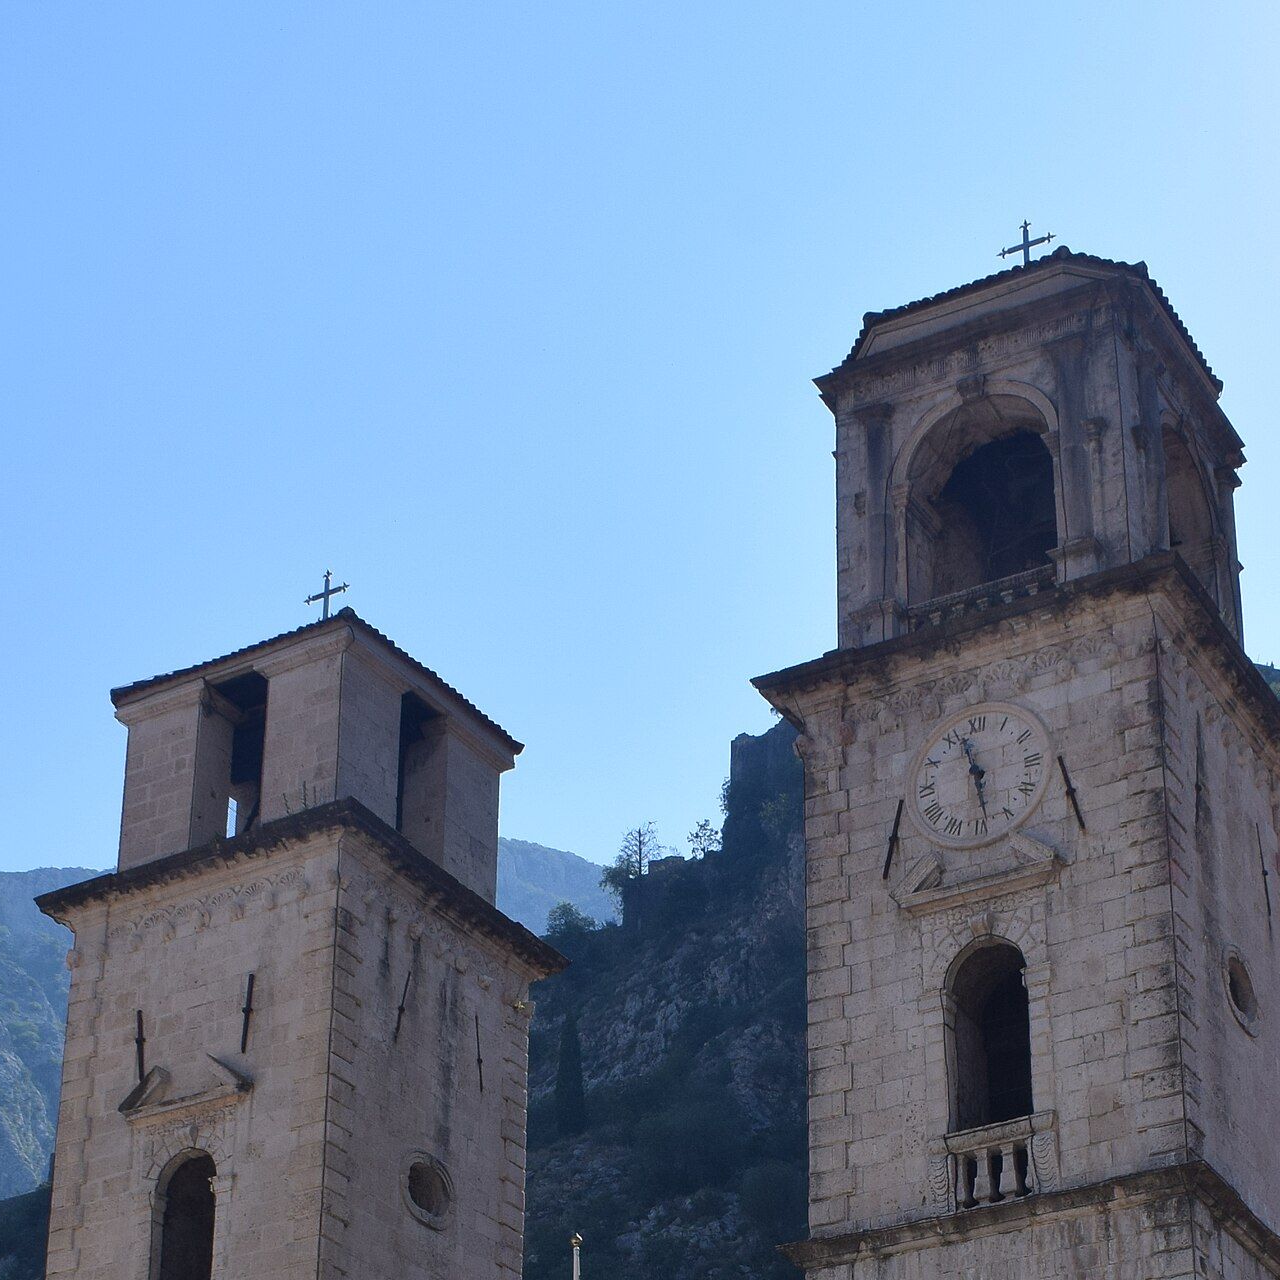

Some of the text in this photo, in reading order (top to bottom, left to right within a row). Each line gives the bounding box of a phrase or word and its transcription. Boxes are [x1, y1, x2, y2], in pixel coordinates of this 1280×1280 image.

[968, 716, 986, 735] XII
[999, 716, 1009, 731] I
[942, 729, 960, 749] XI
[1016, 729, 1032, 744] II
[924, 757, 941, 768] X
[1023, 752, 1044, 768] III
[919, 782, 935, 798] IX
[1018, 781, 1036, 796] IV
[1002, 807, 1014, 820] V
[943, 817, 962, 836] VII
